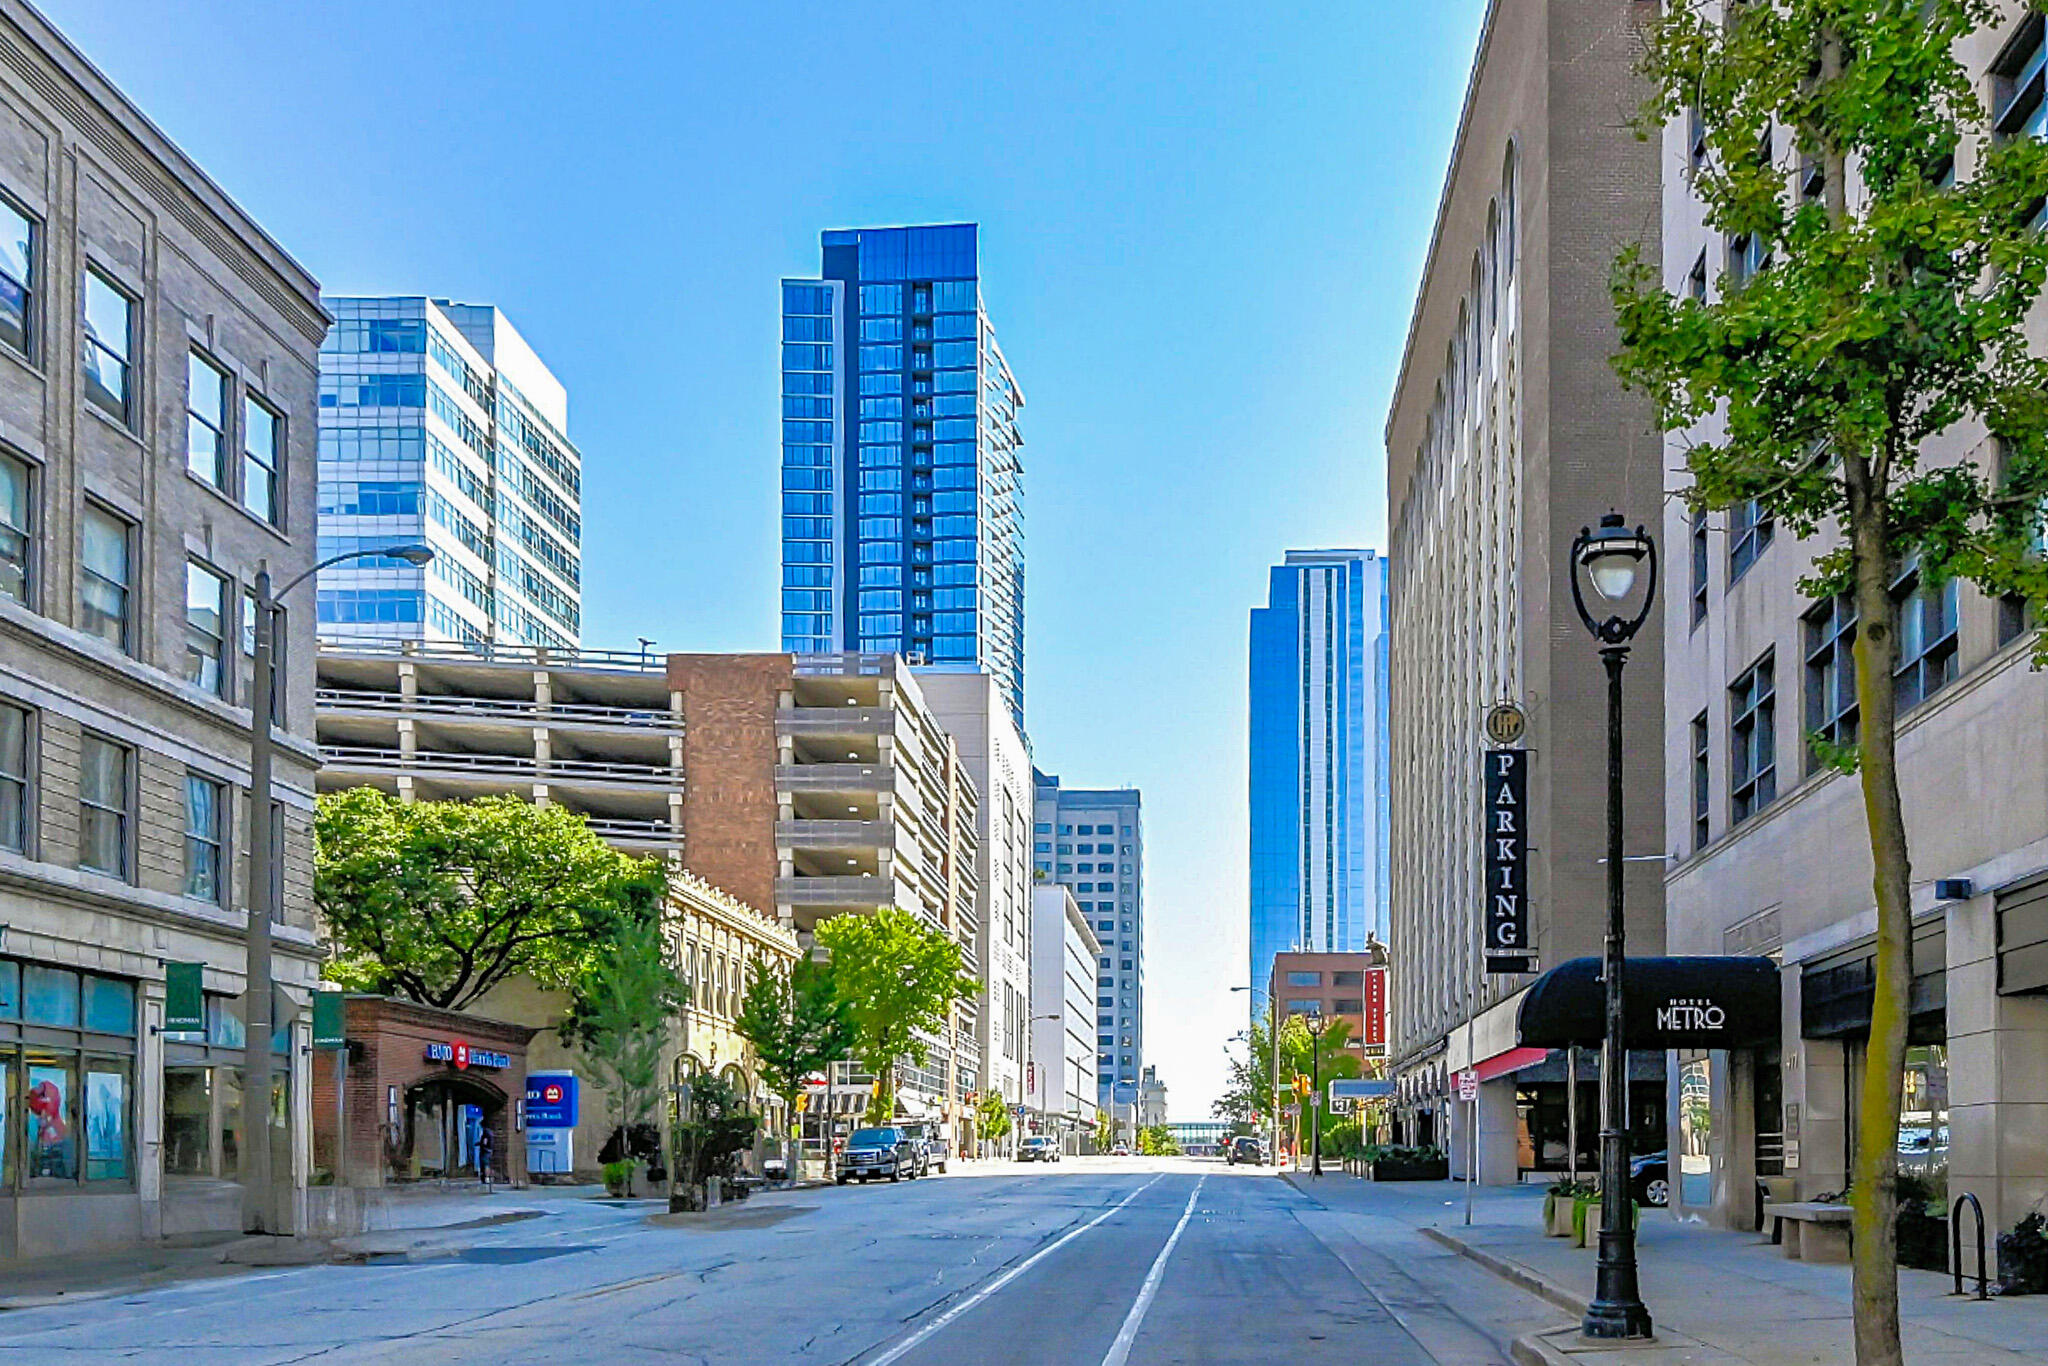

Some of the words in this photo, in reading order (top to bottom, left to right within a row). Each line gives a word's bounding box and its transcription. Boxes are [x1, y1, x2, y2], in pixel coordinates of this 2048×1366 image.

[1495, 754, 1517, 945] PARKING
[1669, 998, 1712, 1006] HOTEL
[1656, 1006, 1726, 1030] METRO
